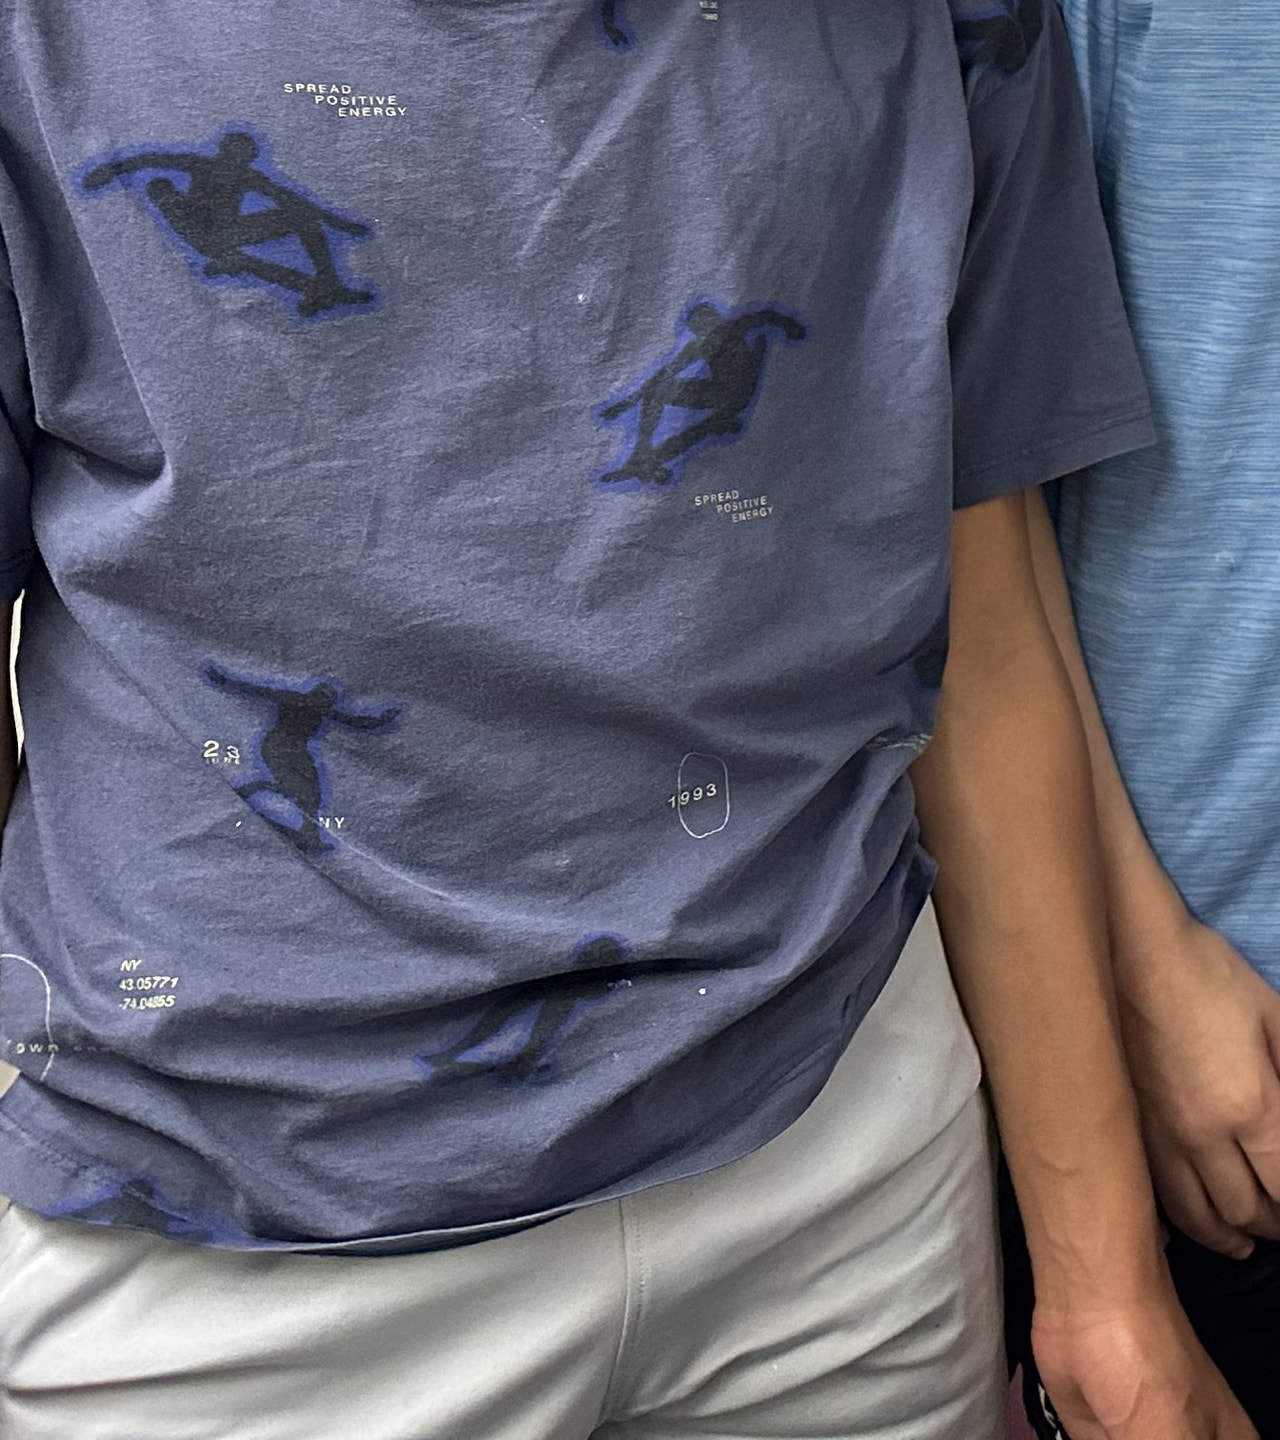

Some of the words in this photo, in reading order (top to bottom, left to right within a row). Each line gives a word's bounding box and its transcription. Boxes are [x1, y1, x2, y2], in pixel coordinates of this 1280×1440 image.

[283, 83, 352, 95] SPREAD
[314, 95, 398, 106] POSITIVE
[338, 106, 407, 117] ENERGY
[694, 489, 740, 506] SPREAD
[716, 495, 769, 514] POSITIVE
[731, 505, 774, 524] ENERGY
[667, 783, 718, 809] 1993
[120, 959, 142, 972] NY
